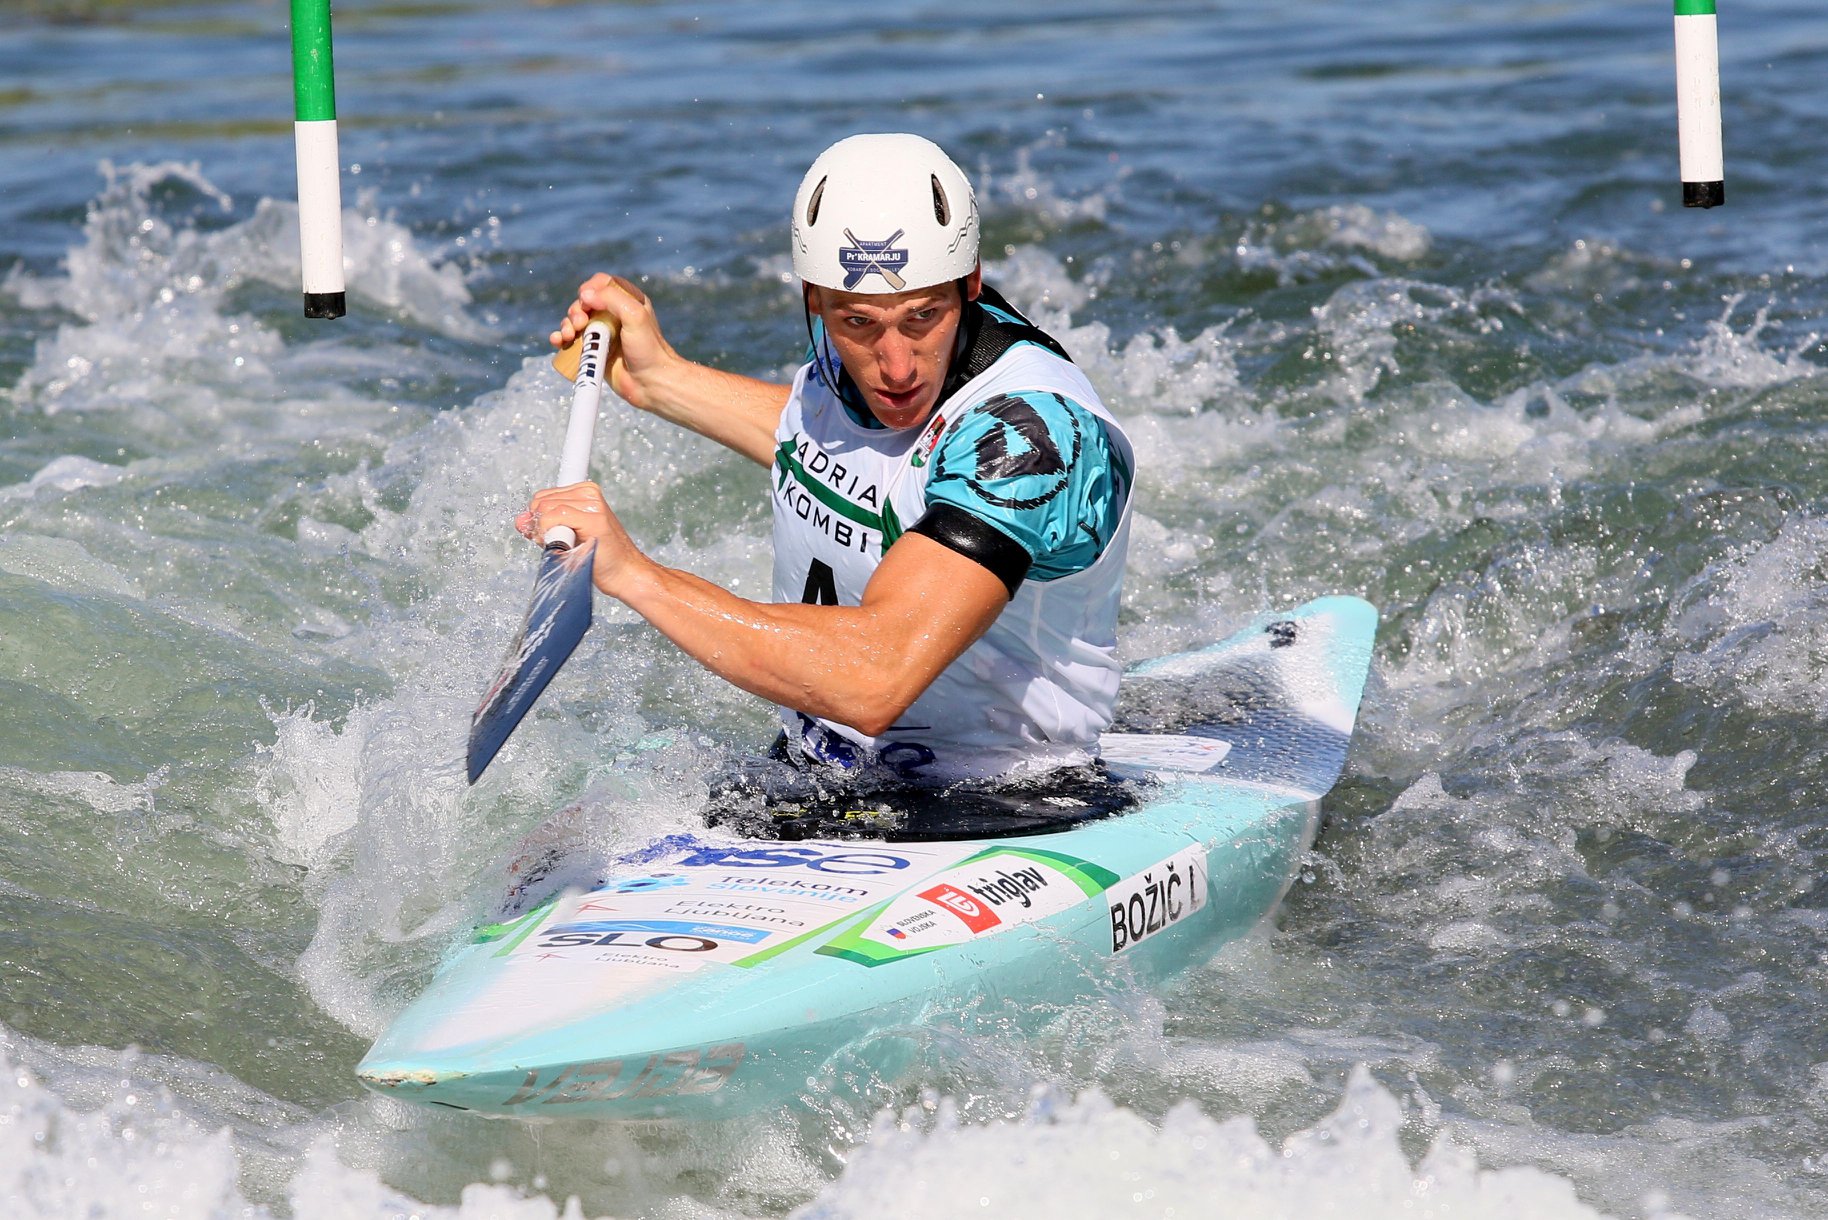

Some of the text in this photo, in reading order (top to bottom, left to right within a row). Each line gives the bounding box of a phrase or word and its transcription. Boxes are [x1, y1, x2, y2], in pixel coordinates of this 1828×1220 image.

[797, 441, 878, 508] ADRIA
[783, 480, 868, 553] KOMBI
[706, 882, 858, 903] Slovenije
[720, 876, 869, 896] Telekom
[967, 866, 1049, 908] triglav
[676, 900, 786, 914] Elektro
[1110, 861, 1182, 953] BOŽIČ
[664, 908, 805, 927] Ljubljana
[896, 909, 936, 927] SLOVENSKA
[908, 920, 937, 934] VOJSKA
[537, 932, 719, 952] SLO
[595, 956, 681, 969] Ljubljana
[602, 952, 668, 962] Elektro
